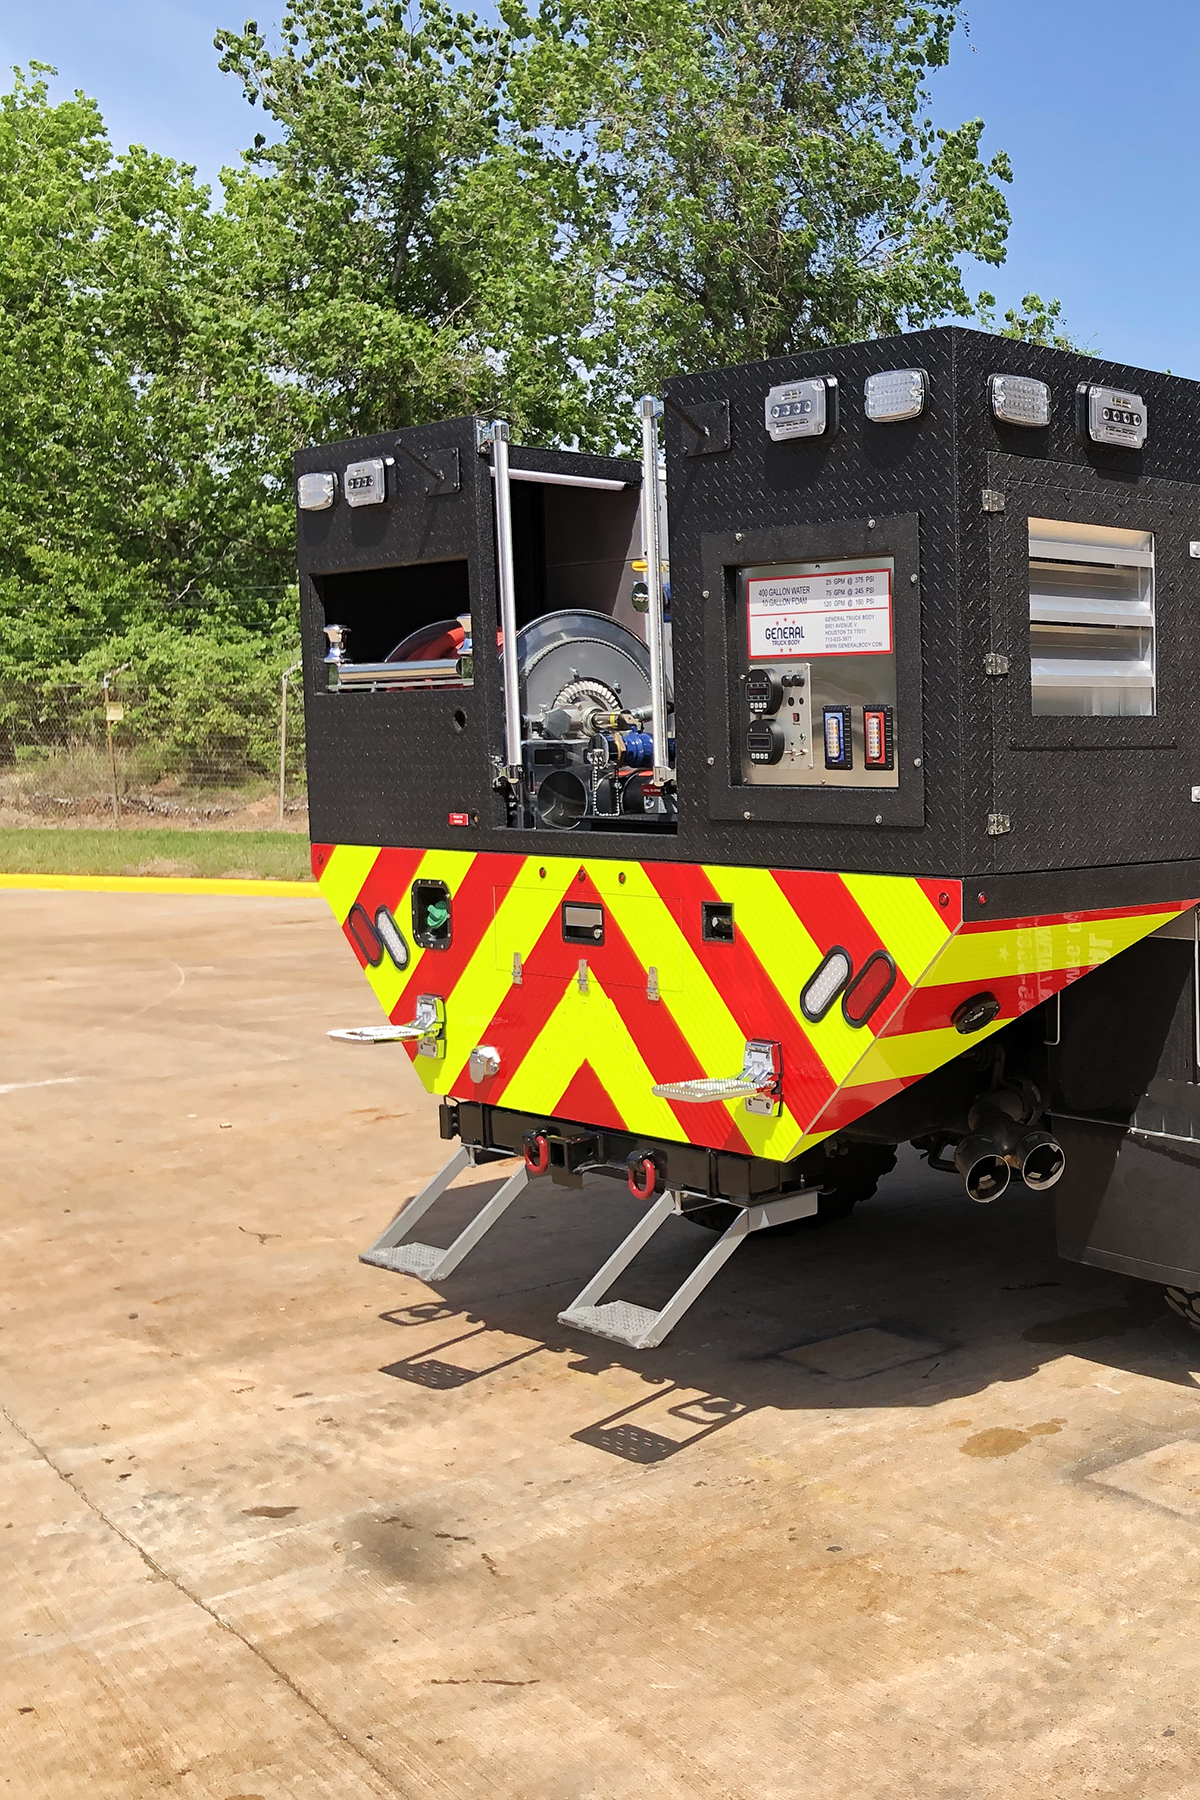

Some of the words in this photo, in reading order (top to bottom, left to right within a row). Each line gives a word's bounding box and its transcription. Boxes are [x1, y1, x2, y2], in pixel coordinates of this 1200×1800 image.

[847, 577, 853, 586] @
[854, 576, 864, 584] 375
[865, 575, 875, 583] PSI
[758, 588, 769, 597] 400
[769, 587, 791, 597] GALLON
[791, 585, 811, 595] WATER
[825, 589, 832, 597] 75
[847, 588, 853, 597] @
[854, 587, 864, 595] 245
[865, 586, 875, 594] PSI
[762, 599, 768, 607] 10
[769, 597, 791, 607] GALLON
[791, 596, 808, 606] FOAM
[823, 600, 832, 608] 120
[833, 599, 846, 607] GPM
[865, 597, 875, 605] PSI
[765, 625, 805, 640] GENERAL
